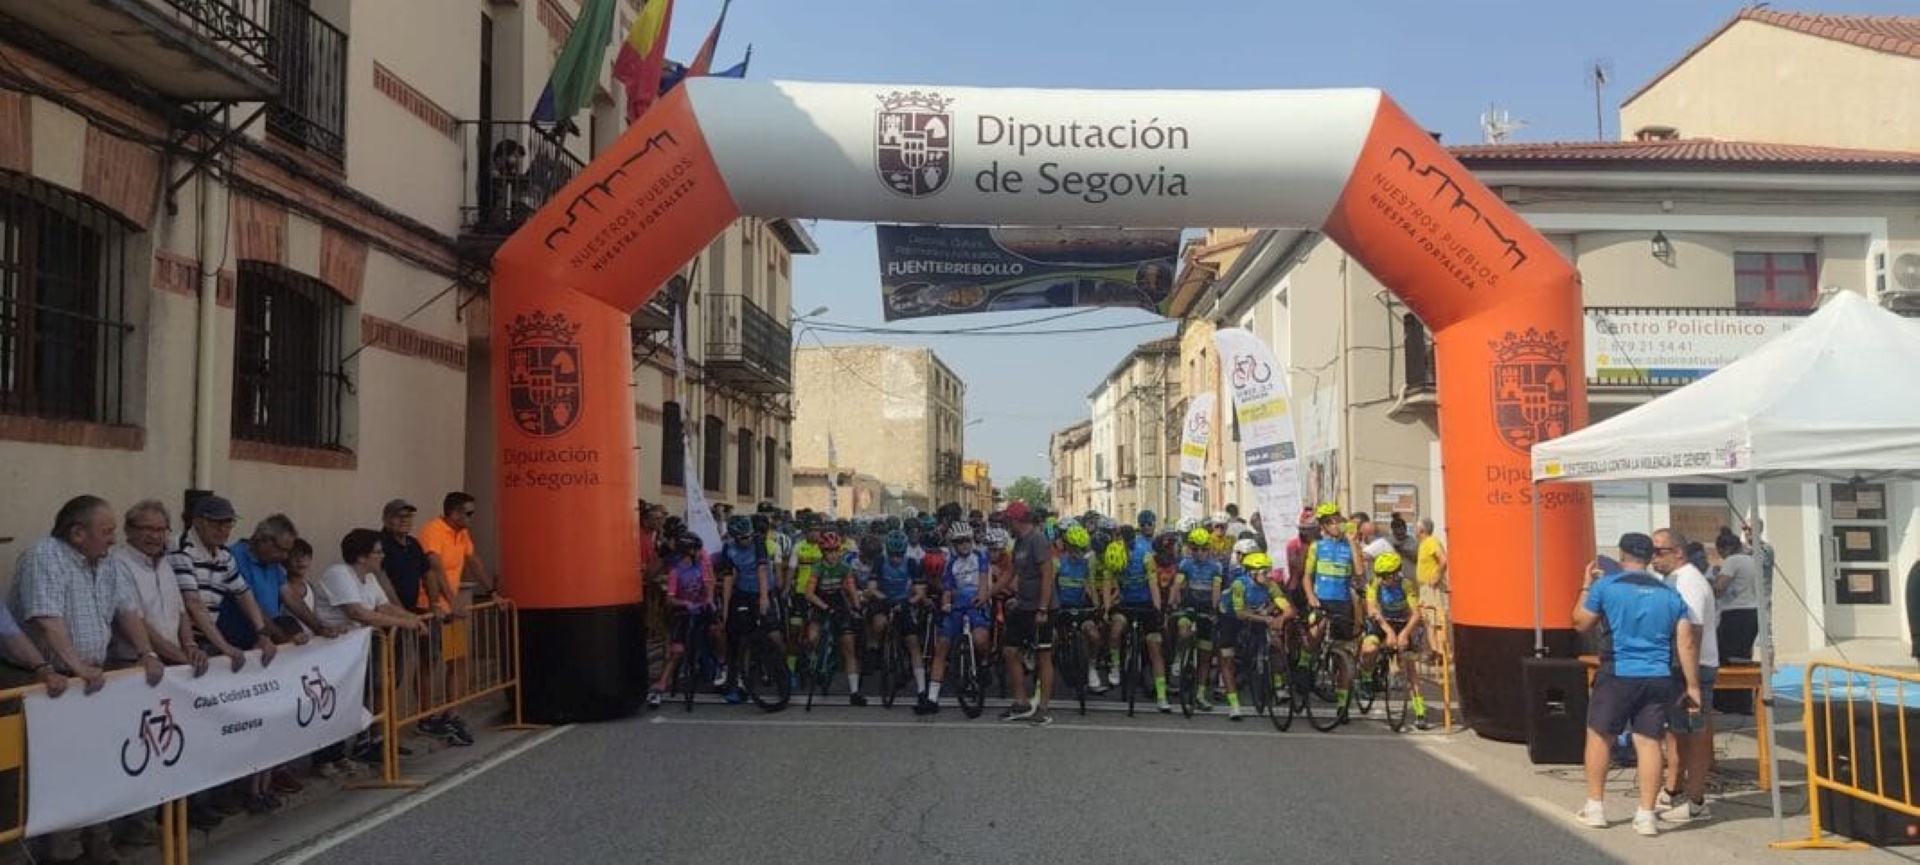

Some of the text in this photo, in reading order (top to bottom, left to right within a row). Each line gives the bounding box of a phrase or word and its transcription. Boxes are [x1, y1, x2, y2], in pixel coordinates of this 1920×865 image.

[976, 113, 1190, 155] Diputación
[975, 161, 1189, 203] de Segovia
[1373, 173, 1438, 232] NUESTROS
[592, 179, 695, 271] NUESTRA FORTALEZA
[572, 209, 636, 268] NUESTROS
[1369, 194, 1476, 291] NUESTRA FORTALEZA
[888, 260, 1025, 275] FUENTERREBOLLO
[1595, 318, 1660, 335] Centro
[502, 445, 599, 466] Diputación
[504, 469, 601, 491] de Segovia
[1487, 489, 1512, 505] de
[193, 695, 219, 709] Club
[221, 718, 263, 735] SEGOVIA
